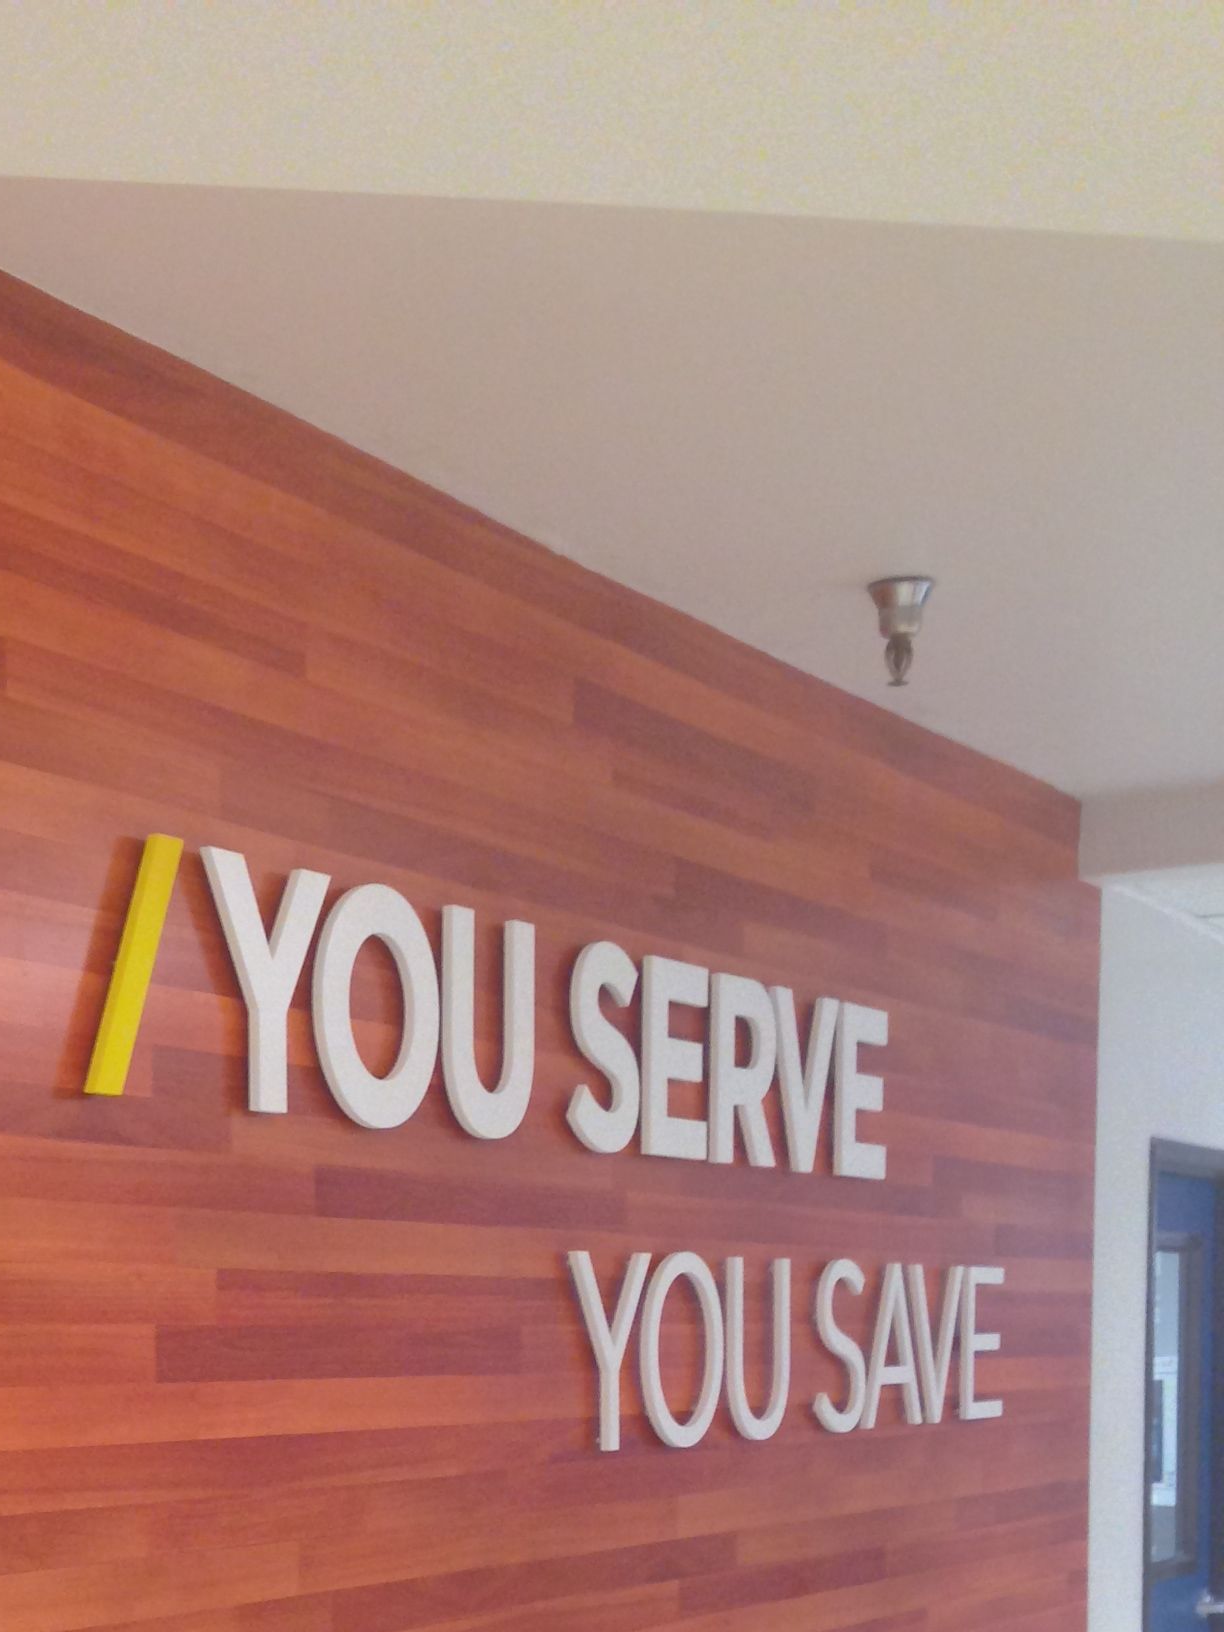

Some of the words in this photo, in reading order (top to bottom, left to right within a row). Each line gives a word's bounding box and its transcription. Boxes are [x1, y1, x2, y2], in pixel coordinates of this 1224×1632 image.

[564, 940, 889, 1180] SERVE
[567, 1250, 792, 1452] YOU
[811, 1257, 1005, 1434] SAVE
